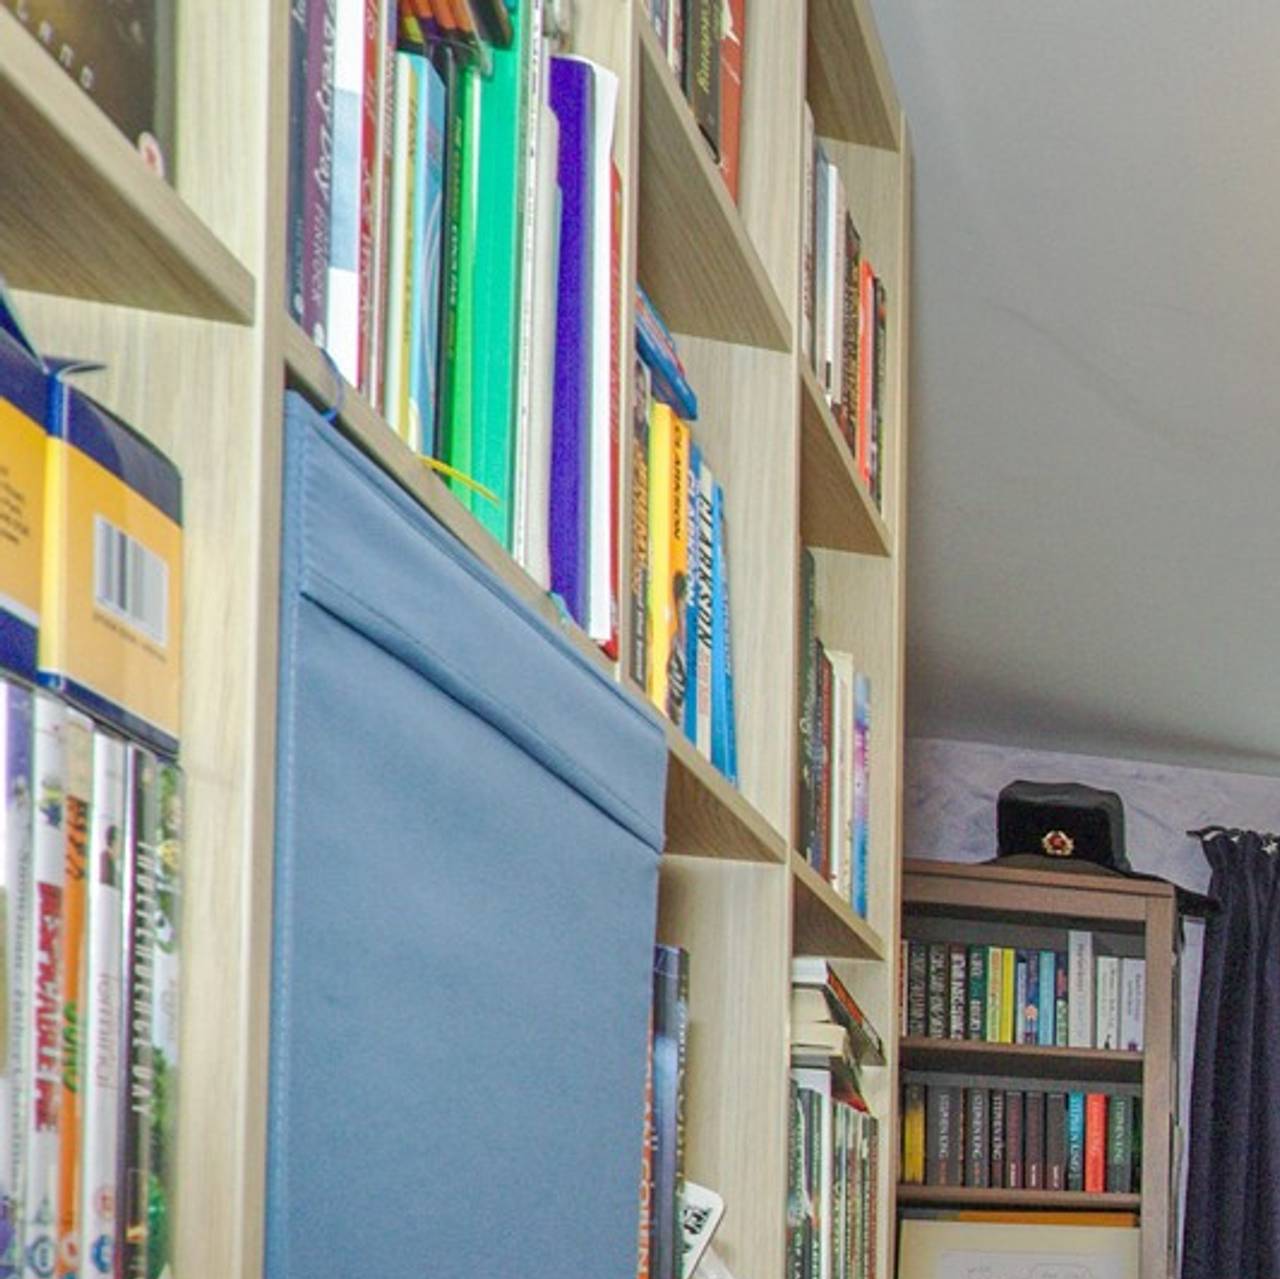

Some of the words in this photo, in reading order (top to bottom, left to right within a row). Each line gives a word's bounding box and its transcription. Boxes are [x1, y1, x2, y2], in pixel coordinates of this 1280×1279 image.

[697, 494, 715, 651] CLARKSON
[36, 880, 64, 1073] DESPICABLE
[131, 840, 158, 1050] INDEPENDENCE
[34, 1076, 61, 1136] ME
[130, 1064, 154, 1121] DAY
